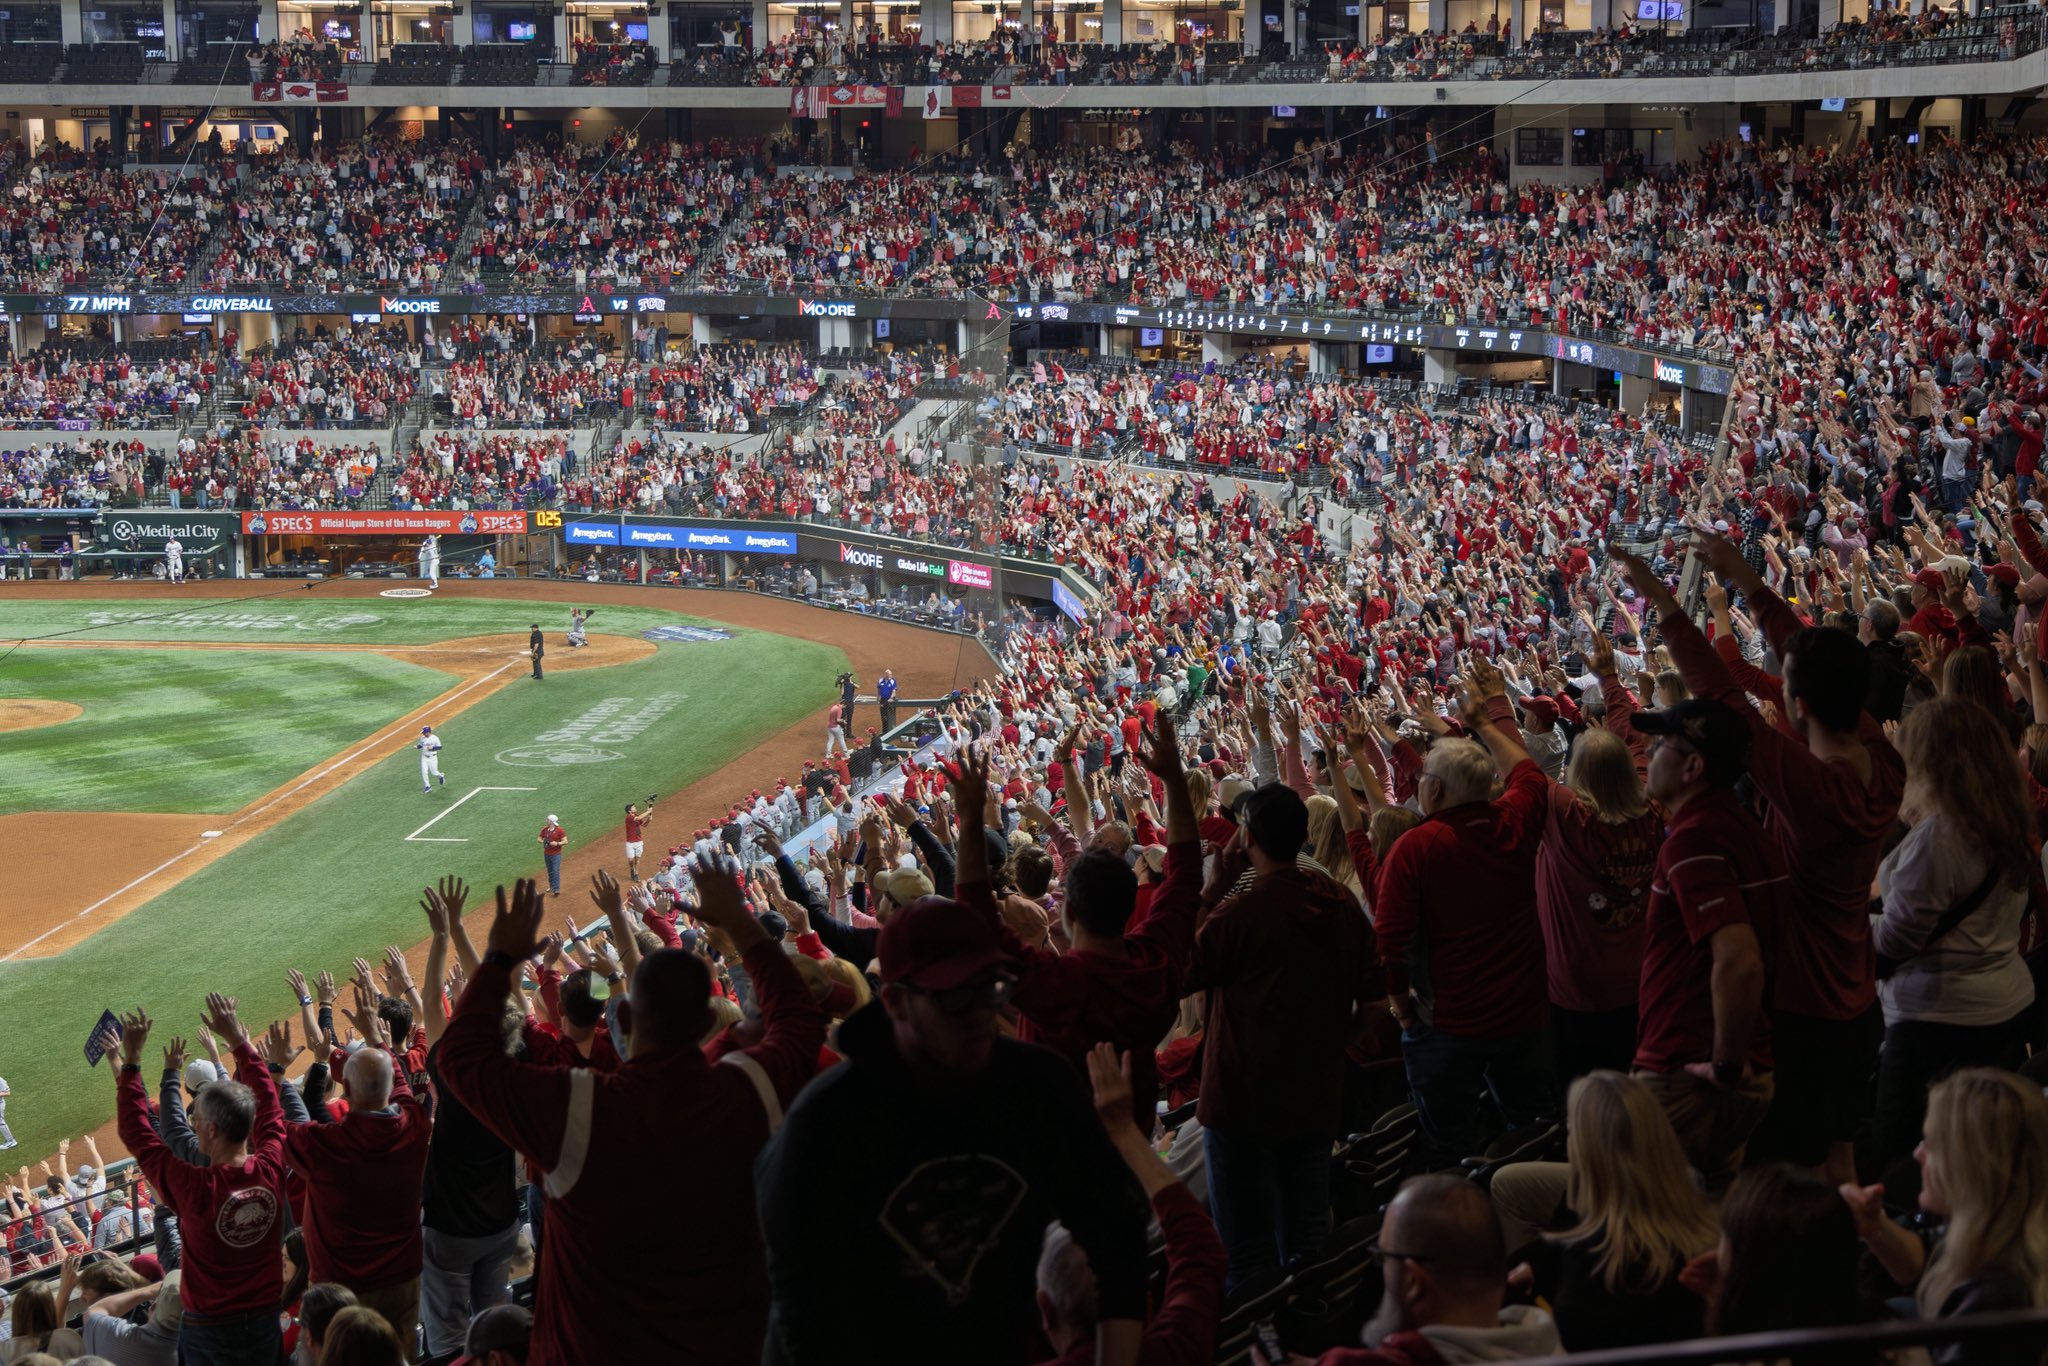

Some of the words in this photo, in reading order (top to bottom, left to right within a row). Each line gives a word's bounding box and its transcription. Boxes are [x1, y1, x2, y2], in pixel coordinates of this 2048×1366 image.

[68, 297, 89, 311] 77
[92, 297, 131, 311] MPH
[192, 298, 273, 311] CURVEBALL
[381, 296, 440, 313] MOORE
[638, 297, 666, 312] TCU
[799, 299, 856, 317] MOORE
[1115, 307, 1140, 317] Arkansas
[1159, 312, 1164, 324] 1
[1116, 316, 1128, 325] TCU
[1177, 313, 1184, 325] 2
[1197, 315, 1204, 327] 3
[1217, 316, 1224, 328] 4
[1238, 318, 1245, 329] 5
[1258, 319, 1266, 331] 6
[1280, 320, 1288, 332] 7
[1301, 322, 1309, 334] 8
[1323, 323, 1331, 335] 9
[1361, 327, 1369, 338] R
[1383, 328, 1392, 339] H
[1406, 330, 1414, 341] E
[1455, 329, 1470, 337] BALL
[1479, 331, 1498, 339] STRIKE
[1509, 332, 1522, 340] OUT
[1458, 337, 1466, 348] 0
[1485, 338, 1492, 349] 0
[1511, 340, 1519, 351] 0
[1653, 356, 1684, 384] MOORE
[62, 420, 85, 431] TCU
[272, 515, 314, 531] SPEC'S
[320, 518, 345, 528] Official
[345, 518, 366, 530] Liquor
[366, 518, 385, 528] Store
[385, 518, 393, 528] of
[393, 518, 405, 528] the
[405, 518, 424, 528] Texas
[425, 518, 451, 529] Rangers
[482, 514, 523, 529] SPEC'S
[536, 511, 562, 527] 025
[137, 525, 191, 538] Medical
[192, 525, 220, 540] City
[839, 542, 884, 569] MOORE
[897, 558, 917, 572] Globe
[916, 561, 929, 574] Life
[928, 564, 945, 576] Field
[961, 565, 988, 578] Shriners
[534, 696, 635, 742] Shriners
